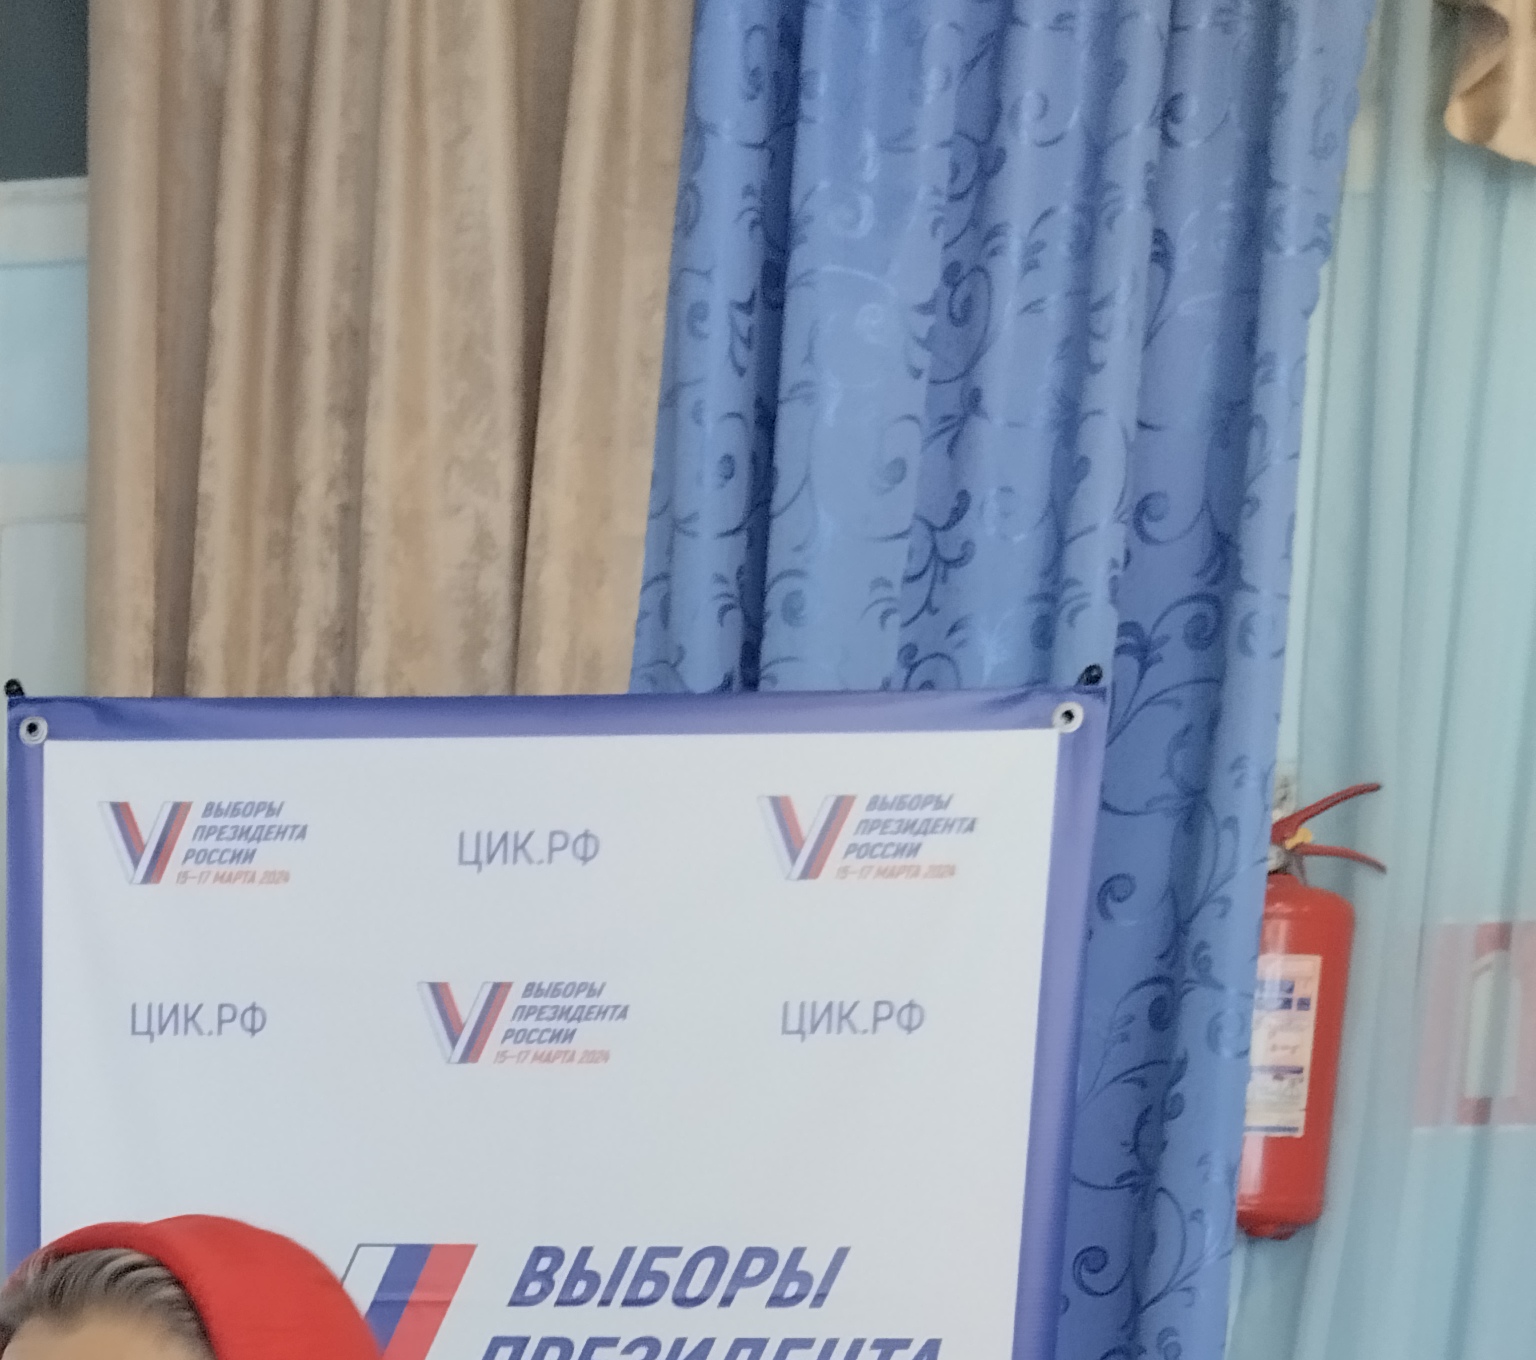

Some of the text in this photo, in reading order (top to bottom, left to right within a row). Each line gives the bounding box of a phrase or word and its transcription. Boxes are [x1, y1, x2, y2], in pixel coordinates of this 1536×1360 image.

[201, 800, 285, 818] ВЫБОРЫ
[865, 793, 954, 811] ВЫБОРЫ
[192, 824, 309, 844] ПРЕЗИДЕНТА
[853, 817, 978, 837] ПРЕЗИДЕНТА
[182, 848, 258, 865] РОССИИ
[458, 829, 600, 874] ЦИК.РФ
[842, 842, 923, 859] РОССИИ
[521, 981, 607, 999] ВЫБОРЫ
[131, 1001, 267, 1044] ЦИК.РФ
[511, 1004, 631, 1023] ПРЕЗИДЕНТА
[781, 999, 925, 1043] ЦИК.РФ
[500, 1028, 577, 1045] РОССИИ
[506, 1245, 851, 1309] ВЫБОРЫ
